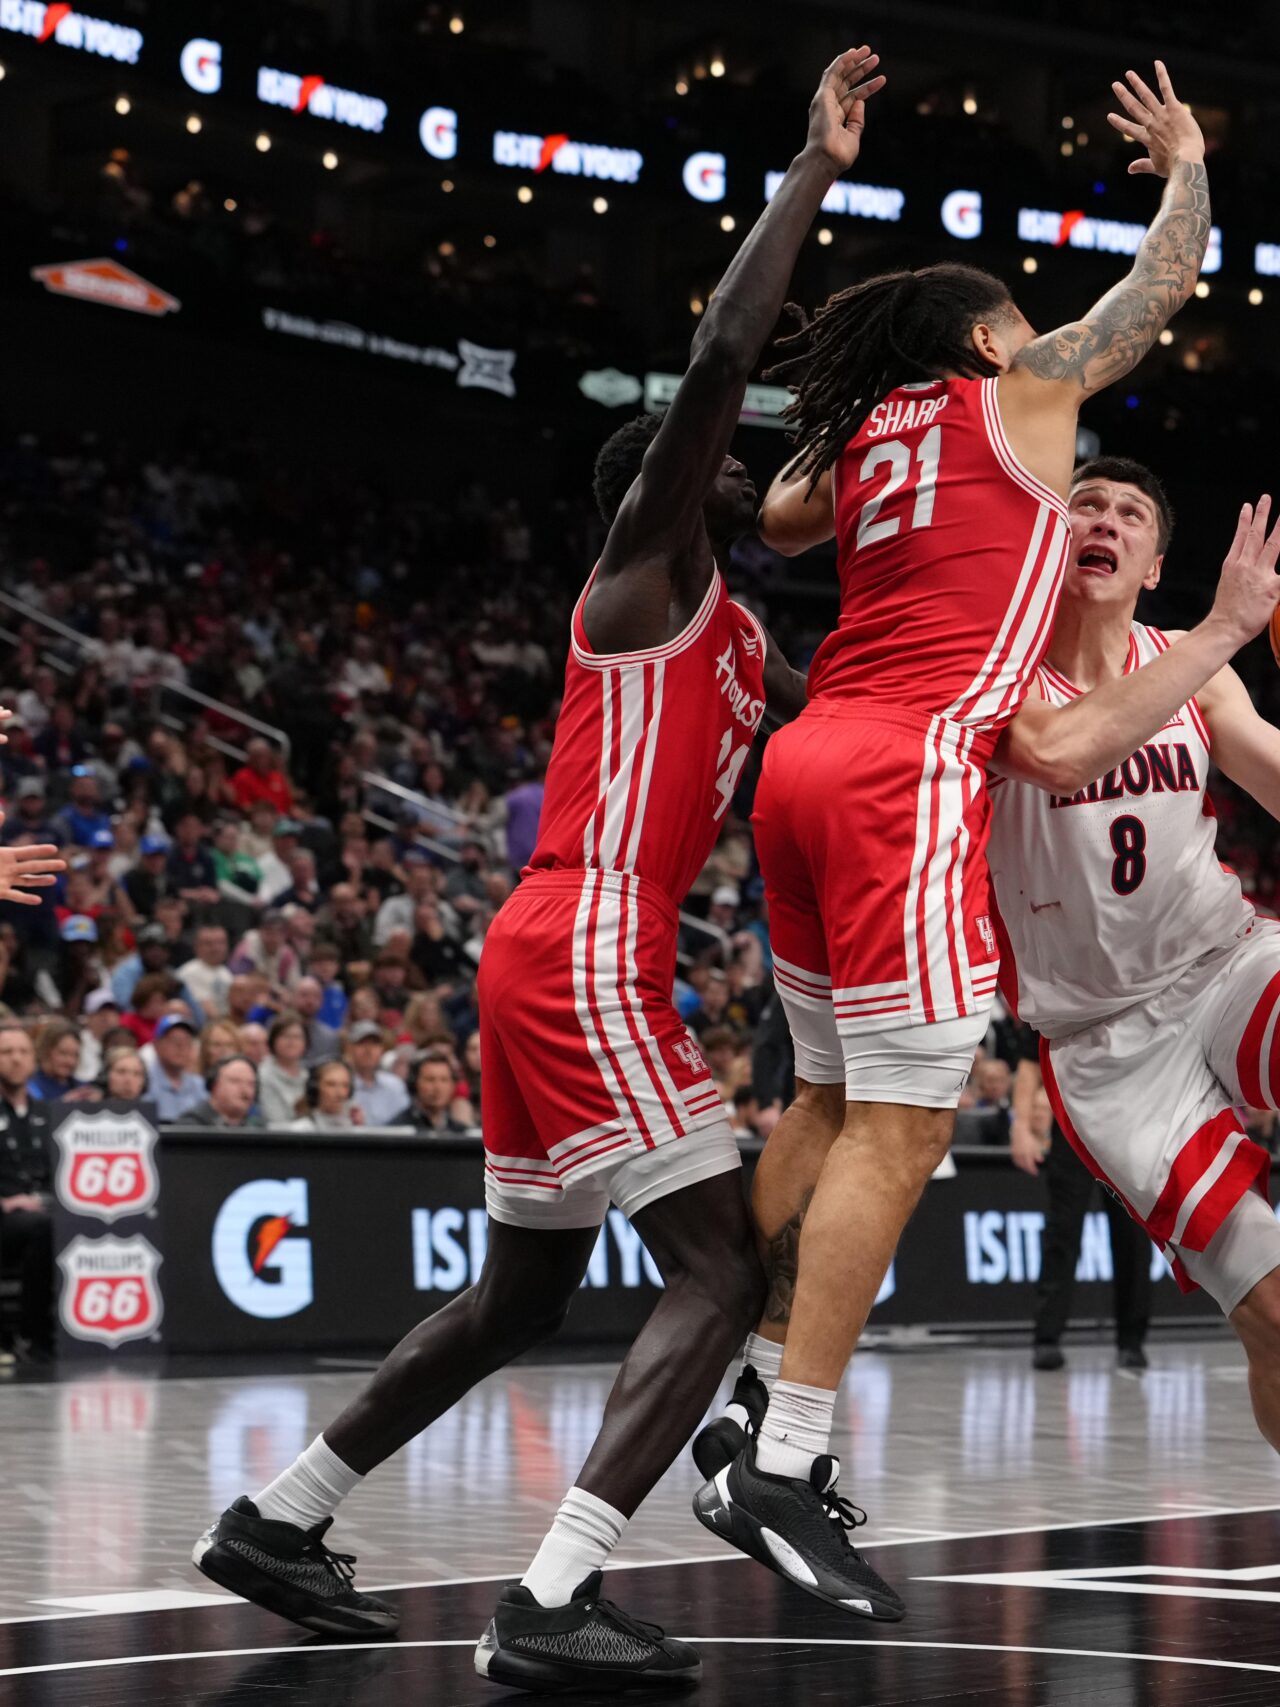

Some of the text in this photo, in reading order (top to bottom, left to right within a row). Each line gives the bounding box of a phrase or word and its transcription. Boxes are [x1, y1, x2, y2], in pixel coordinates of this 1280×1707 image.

[180, 38, 222, 94] G
[419, 107, 457, 160] G
[683, 152, 726, 202] G
[941, 190, 982, 239] G
[867, 394, 948, 438] SHARP
[856, 424, 941, 552] 21
[713, 726, 749, 821] 14
[1109, 815, 1146, 896] 8
[74, 1129, 140, 1149] PHILLIPS
[76, 1156, 138, 1198] 66
[77, 1253, 145, 1271] PHILLIPS
[211, 1178, 314, 1319] G
[79, 1280, 142, 1322] 66
